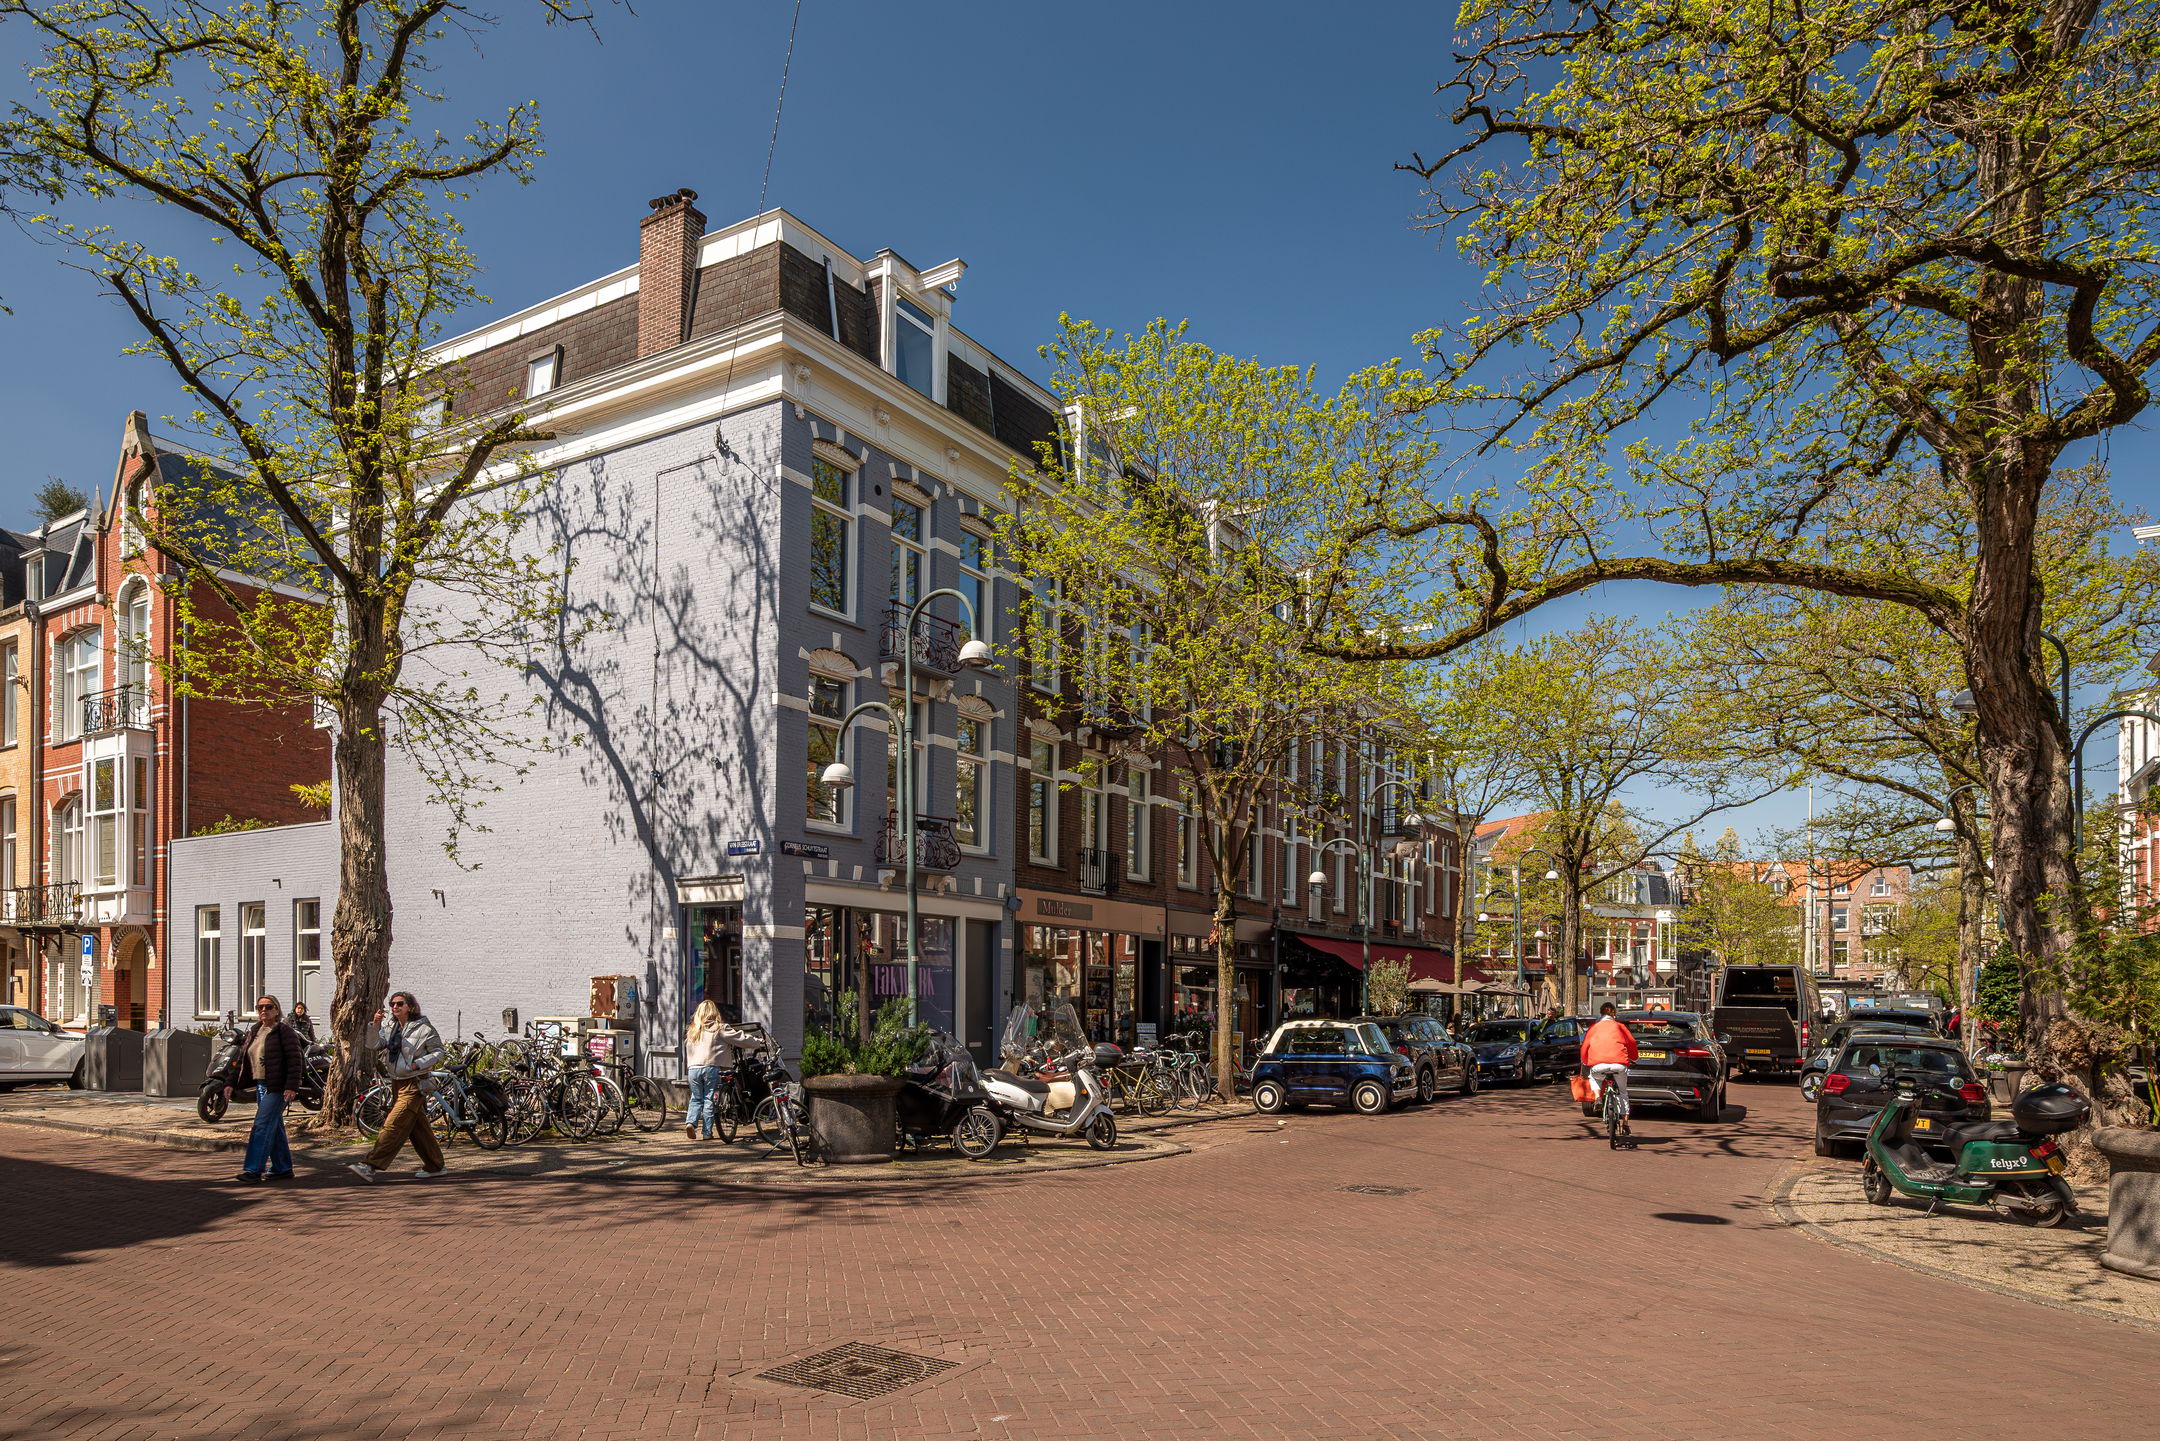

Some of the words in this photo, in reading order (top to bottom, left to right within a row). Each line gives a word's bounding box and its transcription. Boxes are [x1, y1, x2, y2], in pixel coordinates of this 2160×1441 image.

[1042, 900, 1072, 916] Mulder
[84, 937, 91, 953] P
[1990, 1158, 2020, 1170] felyx
